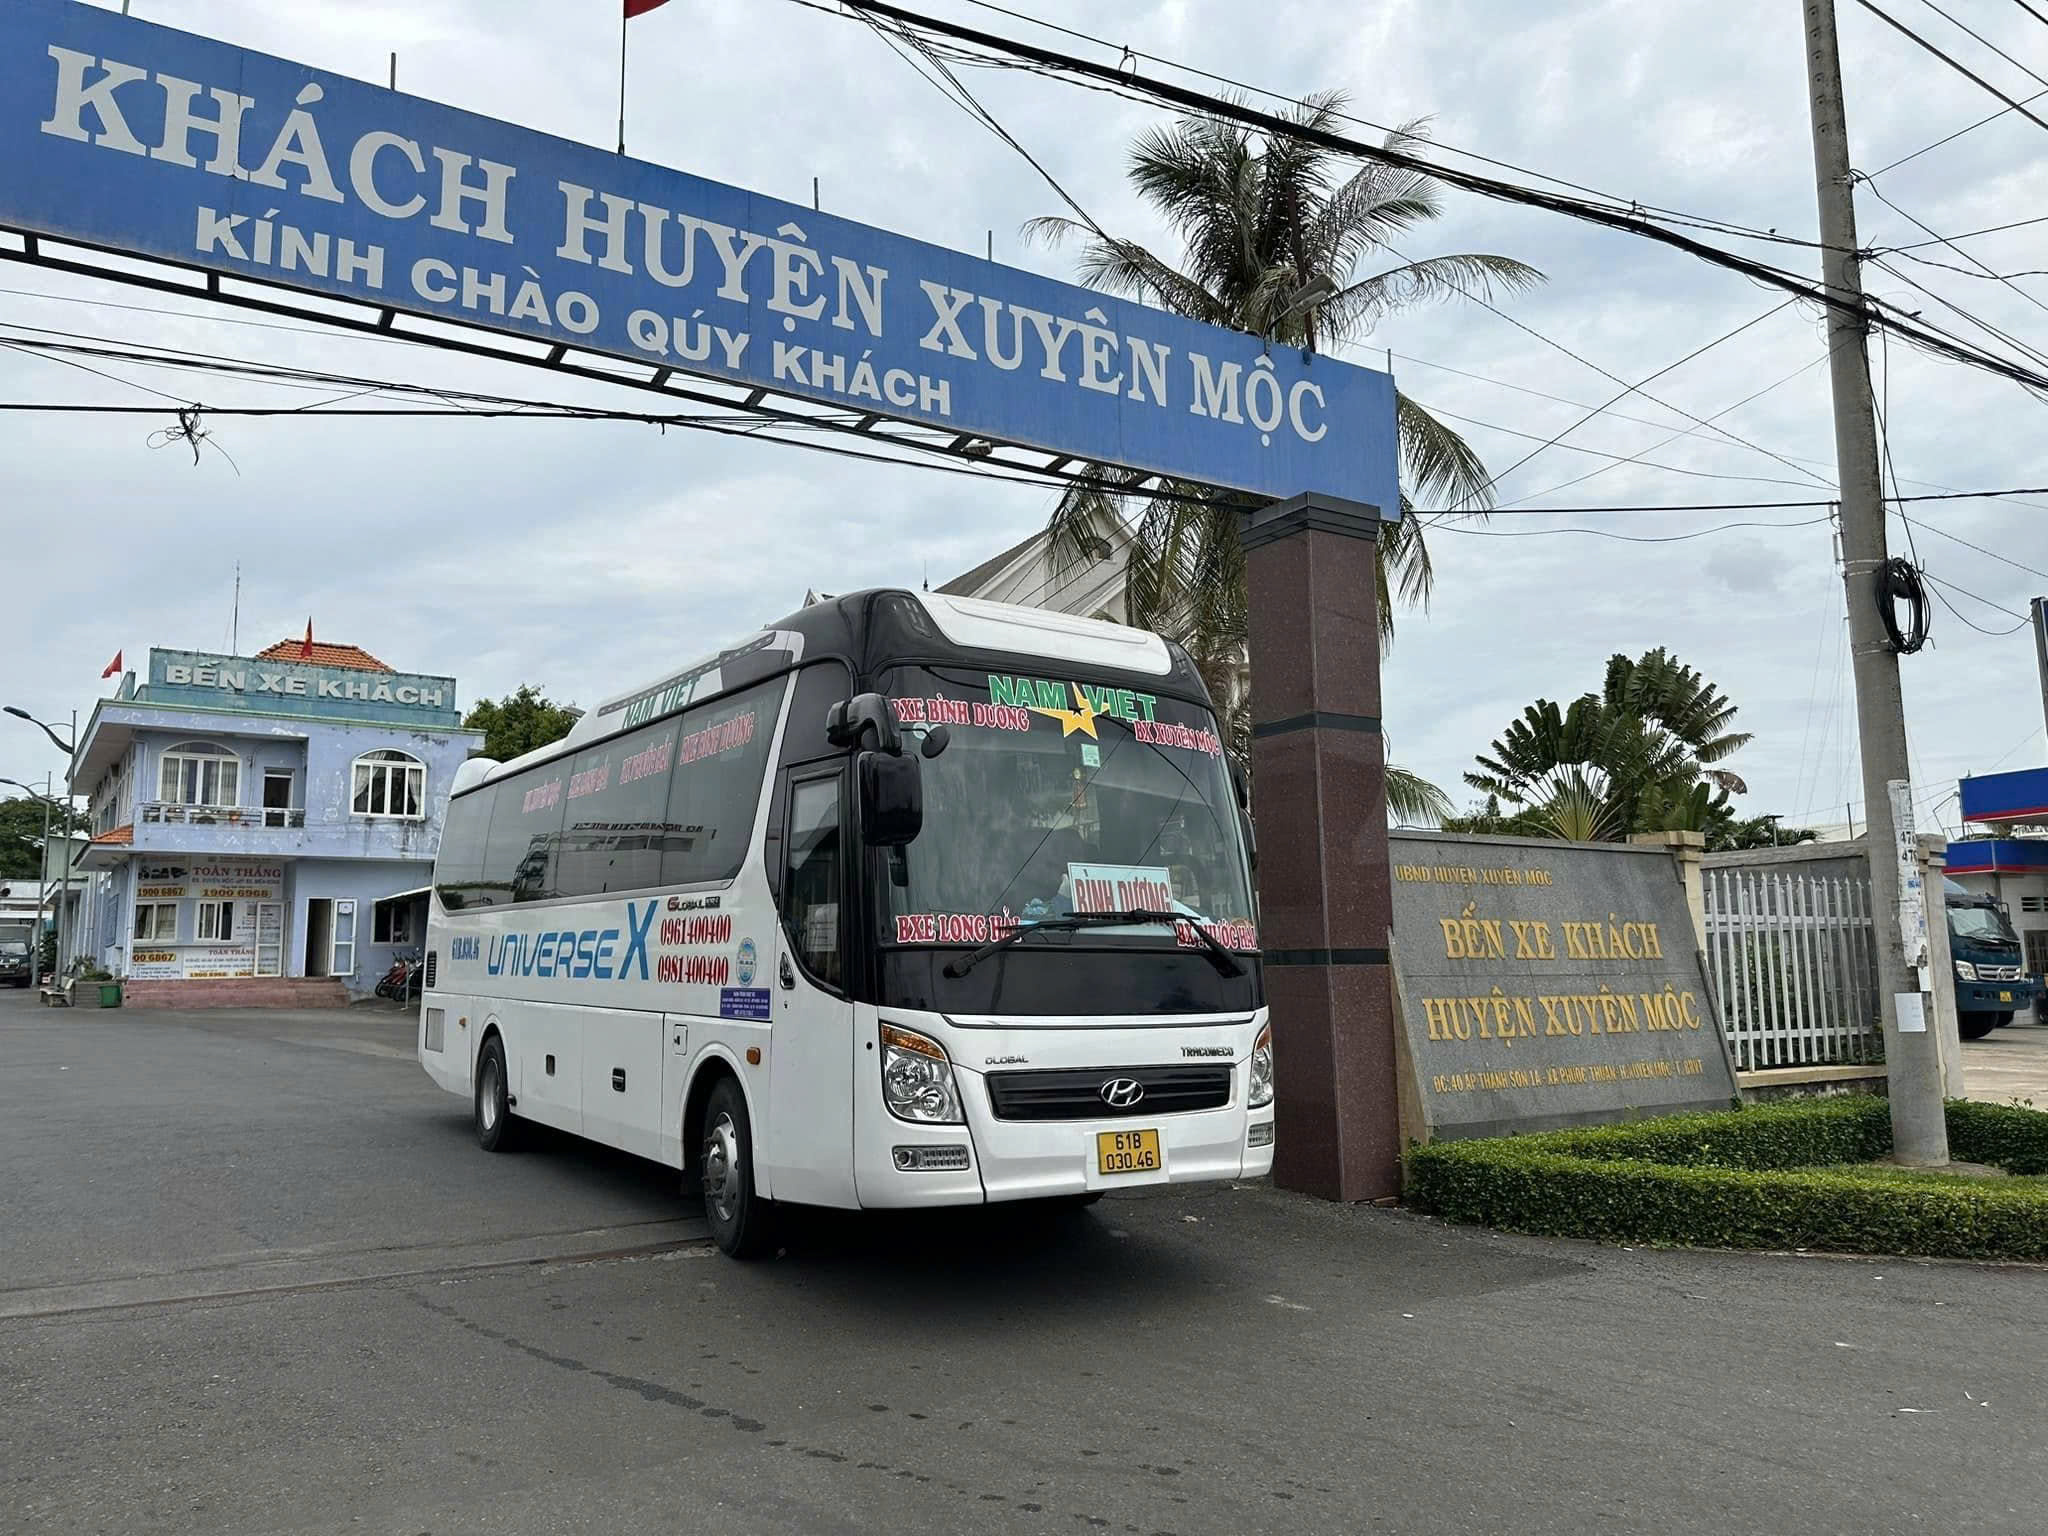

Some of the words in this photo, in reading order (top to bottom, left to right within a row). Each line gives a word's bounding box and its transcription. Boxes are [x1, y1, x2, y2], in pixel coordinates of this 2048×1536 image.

[41, 45, 516, 245] KHÁCH
[556, 180, 888, 337] HUYỆN
[919, 280, 1171, 407] XUYÊN
[1189, 351, 1328, 447] MỘC
[196, 206, 385, 289] KÍNH
[411, 258, 600, 334] CHÀO
[627, 309, 749, 370] QÚY
[773, 341, 951, 416] KHÁCH
[166, 660, 245, 690] BẾN
[256, 673, 306, 695] XE
[317, 679, 442, 707] KHÁCH
[988, 674, 1067, 711] NAM
[1082, 684, 1156, 722] VIỆT
[1134, 720, 1155, 743] BX
[1394, 865, 1431, 882] UBND
[896, 914, 936, 943] BXE
[938, 914, 987, 943] LONG
[1440, 901, 1505, 959] BẾN
[1509, 920, 1556, 959] XE
[1561, 912, 1664, 960] KHÁCH
[1423, 985, 1537, 1048] HUYỆN
[1538, 984, 1640, 1036] XUYÊN
[1640, 983, 1700, 1040] MỘC
[985, 1055, 1029, 1065] GLOBAL
[1106, 1150, 1154, 1170] 030.46
[1114, 1132, 1141, 1150] 61B
